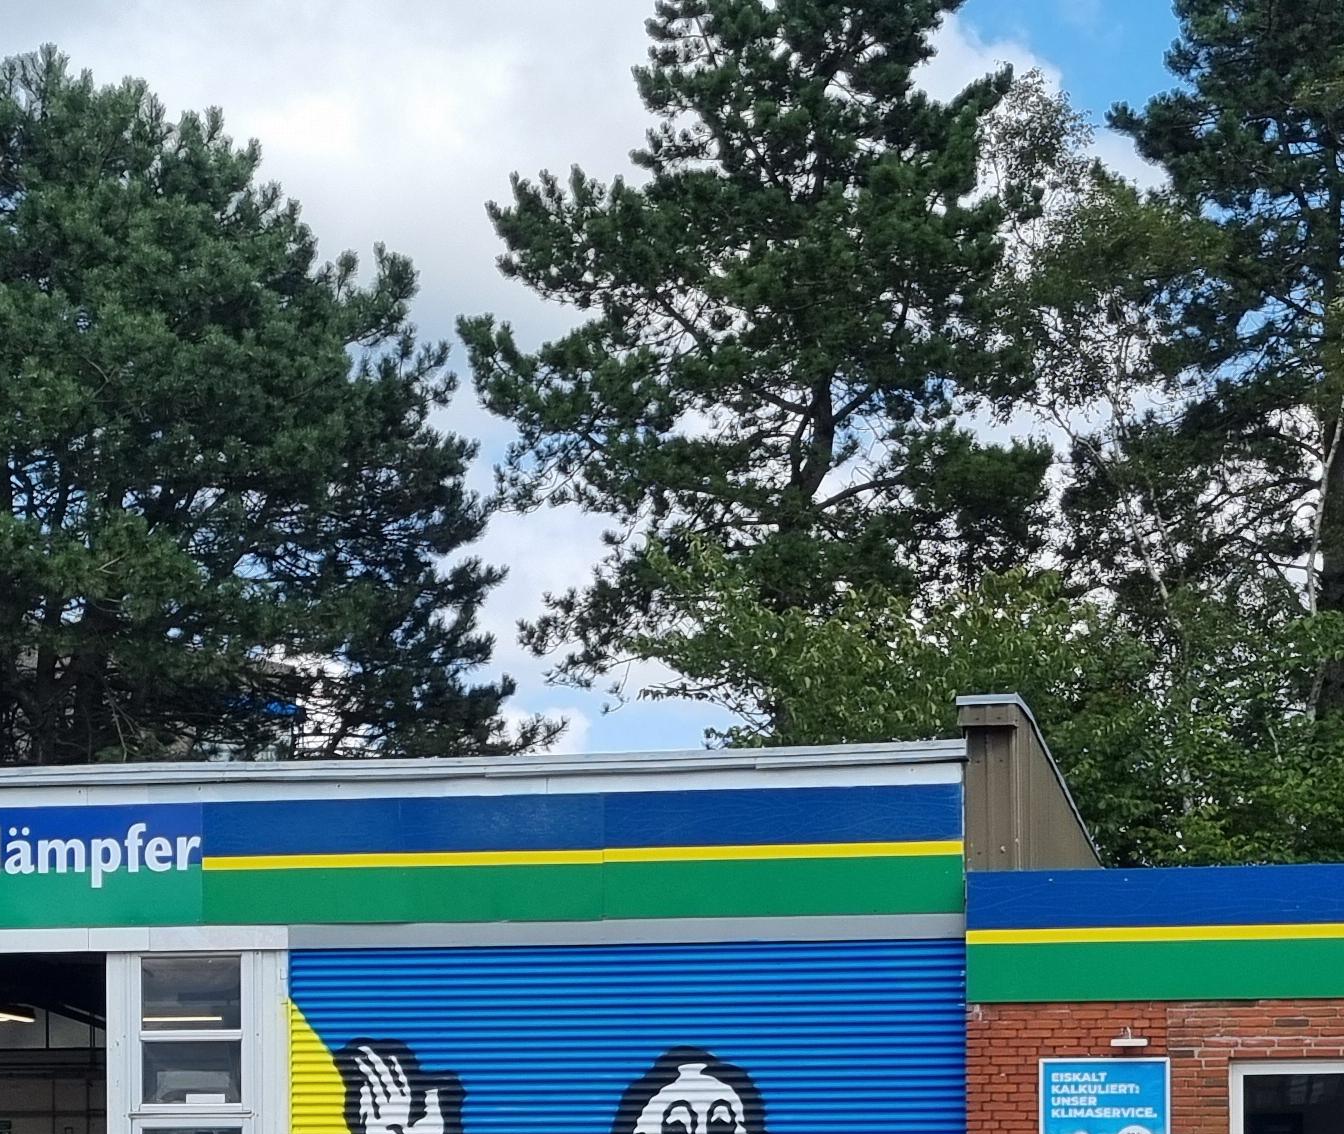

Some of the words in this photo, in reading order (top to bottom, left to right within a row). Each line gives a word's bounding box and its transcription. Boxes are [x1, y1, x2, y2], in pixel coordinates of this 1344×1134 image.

[1051, 1072, 1107, 1083] EISKALT
[1051, 1083, 1140, 1095] KALKULIERT:
[1051, 1095, 1098, 1106] UNSER
[1051, 1107, 1158, 1118] KLIMASERVICE.
